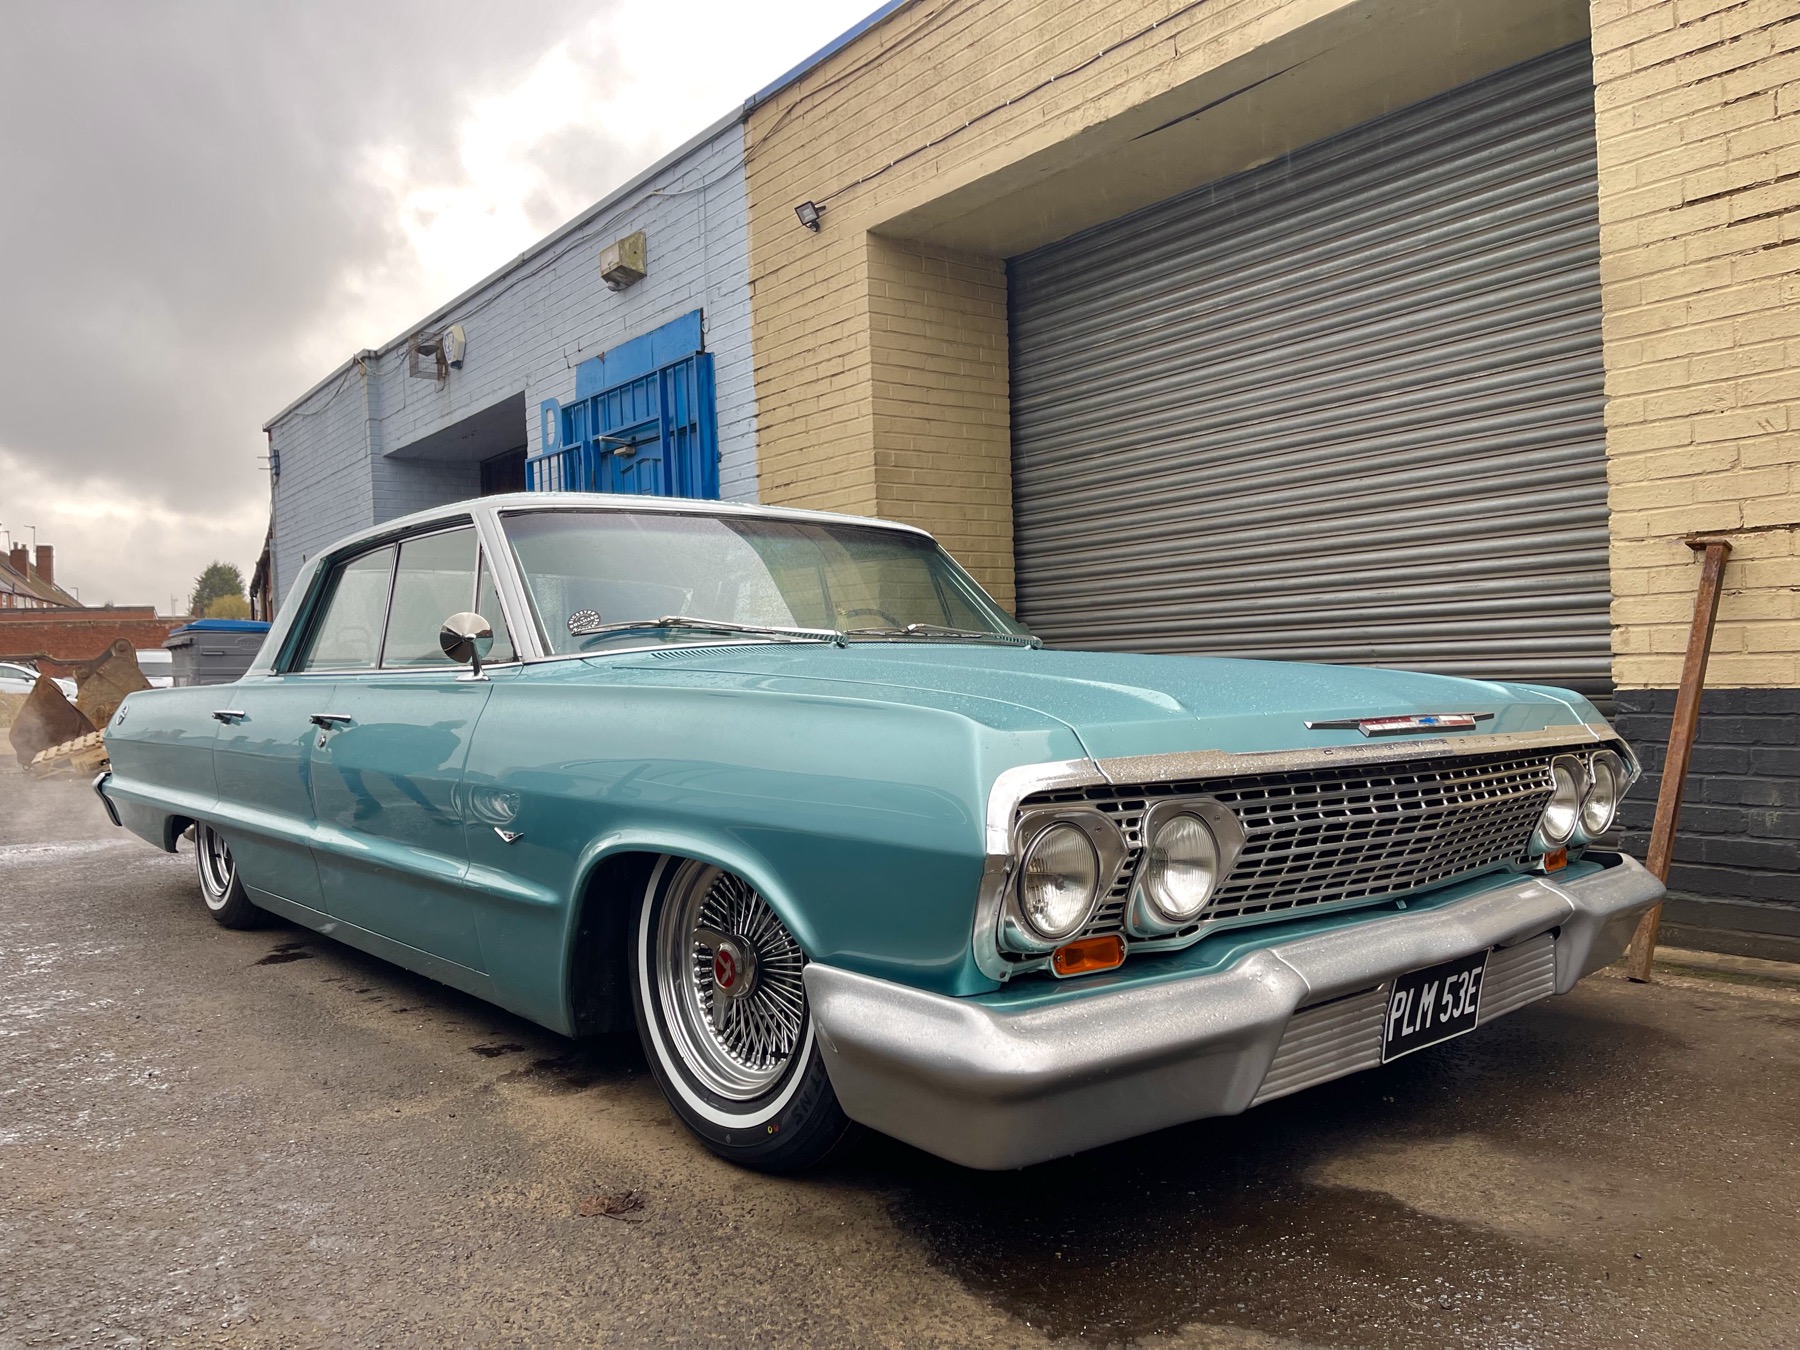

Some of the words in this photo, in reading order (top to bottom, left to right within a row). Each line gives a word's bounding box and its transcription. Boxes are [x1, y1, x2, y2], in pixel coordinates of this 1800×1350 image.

[541, 397, 561, 454] D
[1387, 980, 1440, 1042] PLM
[1439, 966, 1483, 1023] 53E
